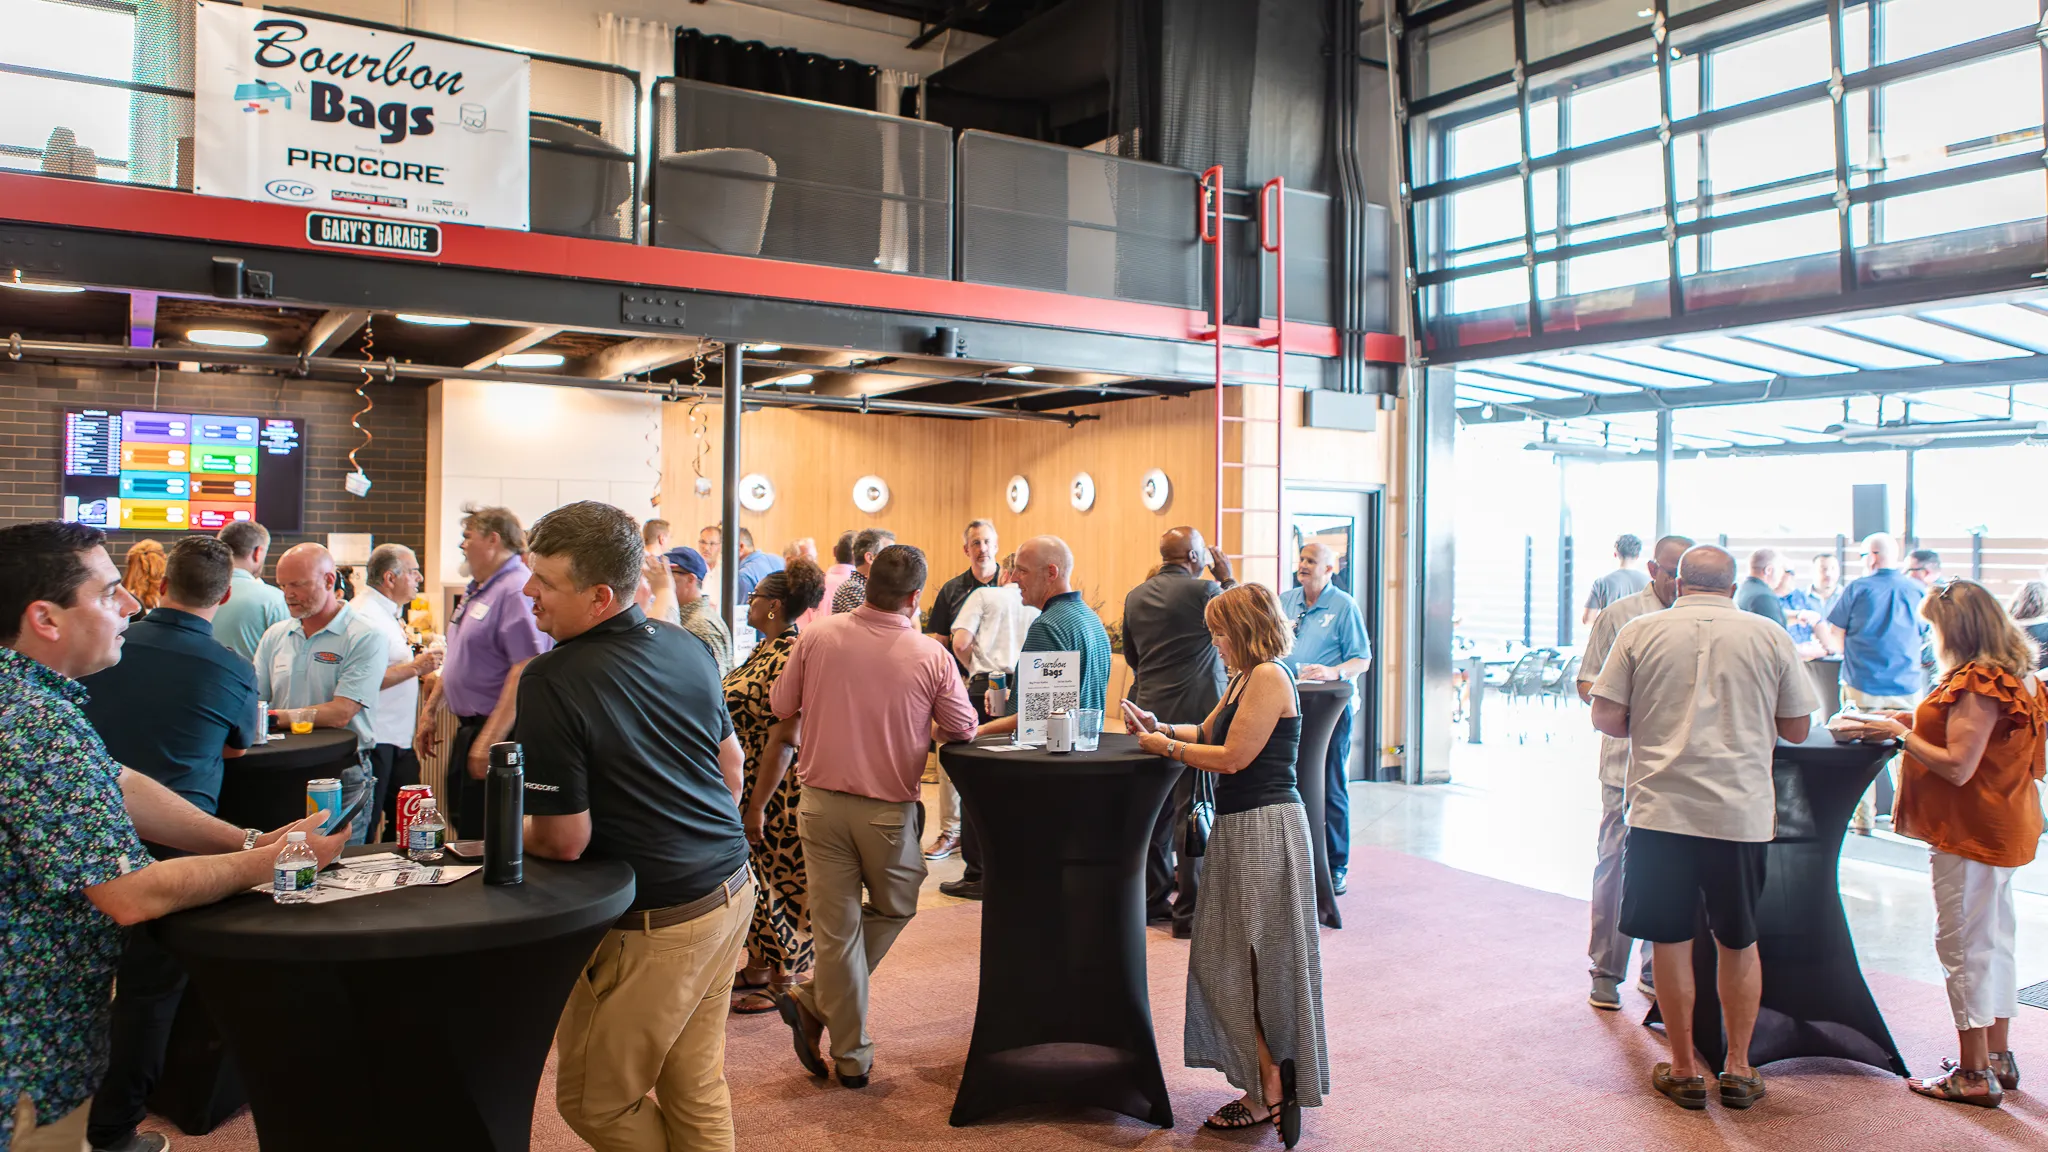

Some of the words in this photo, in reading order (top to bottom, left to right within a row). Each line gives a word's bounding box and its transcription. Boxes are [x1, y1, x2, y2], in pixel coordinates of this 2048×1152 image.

[253, 19, 465, 96] Bourbon
[294, 81, 307, 94] &
[310, 79, 435, 144] Bags
[287, 147, 445, 185] PROCORE
[275, 184, 314, 197] PCP
[321, 217, 371, 244] GARY'S
[374, 223, 428, 250] GARAGE
[1033, 657, 1067, 669] Bourbon
[1043, 668, 1062, 679] Bags
